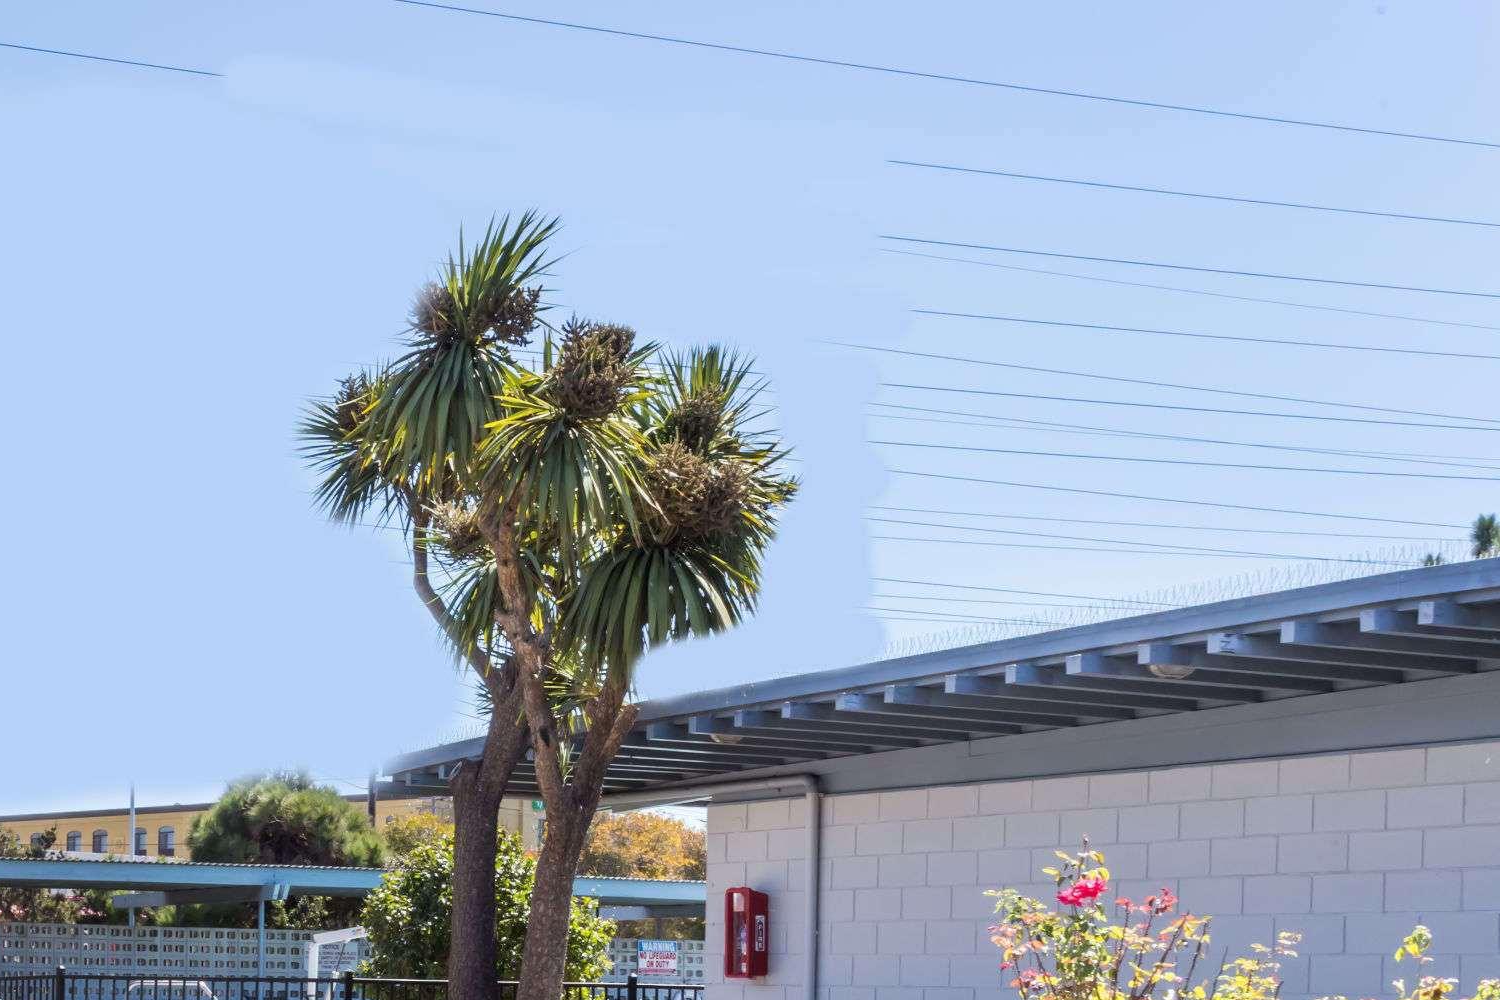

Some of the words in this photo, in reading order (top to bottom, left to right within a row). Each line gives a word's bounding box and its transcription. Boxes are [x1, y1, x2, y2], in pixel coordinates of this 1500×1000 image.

[642, 942, 675, 951] WARNING
[646, 960, 654, 968] ON
[655, 960, 669, 968] DUTY
